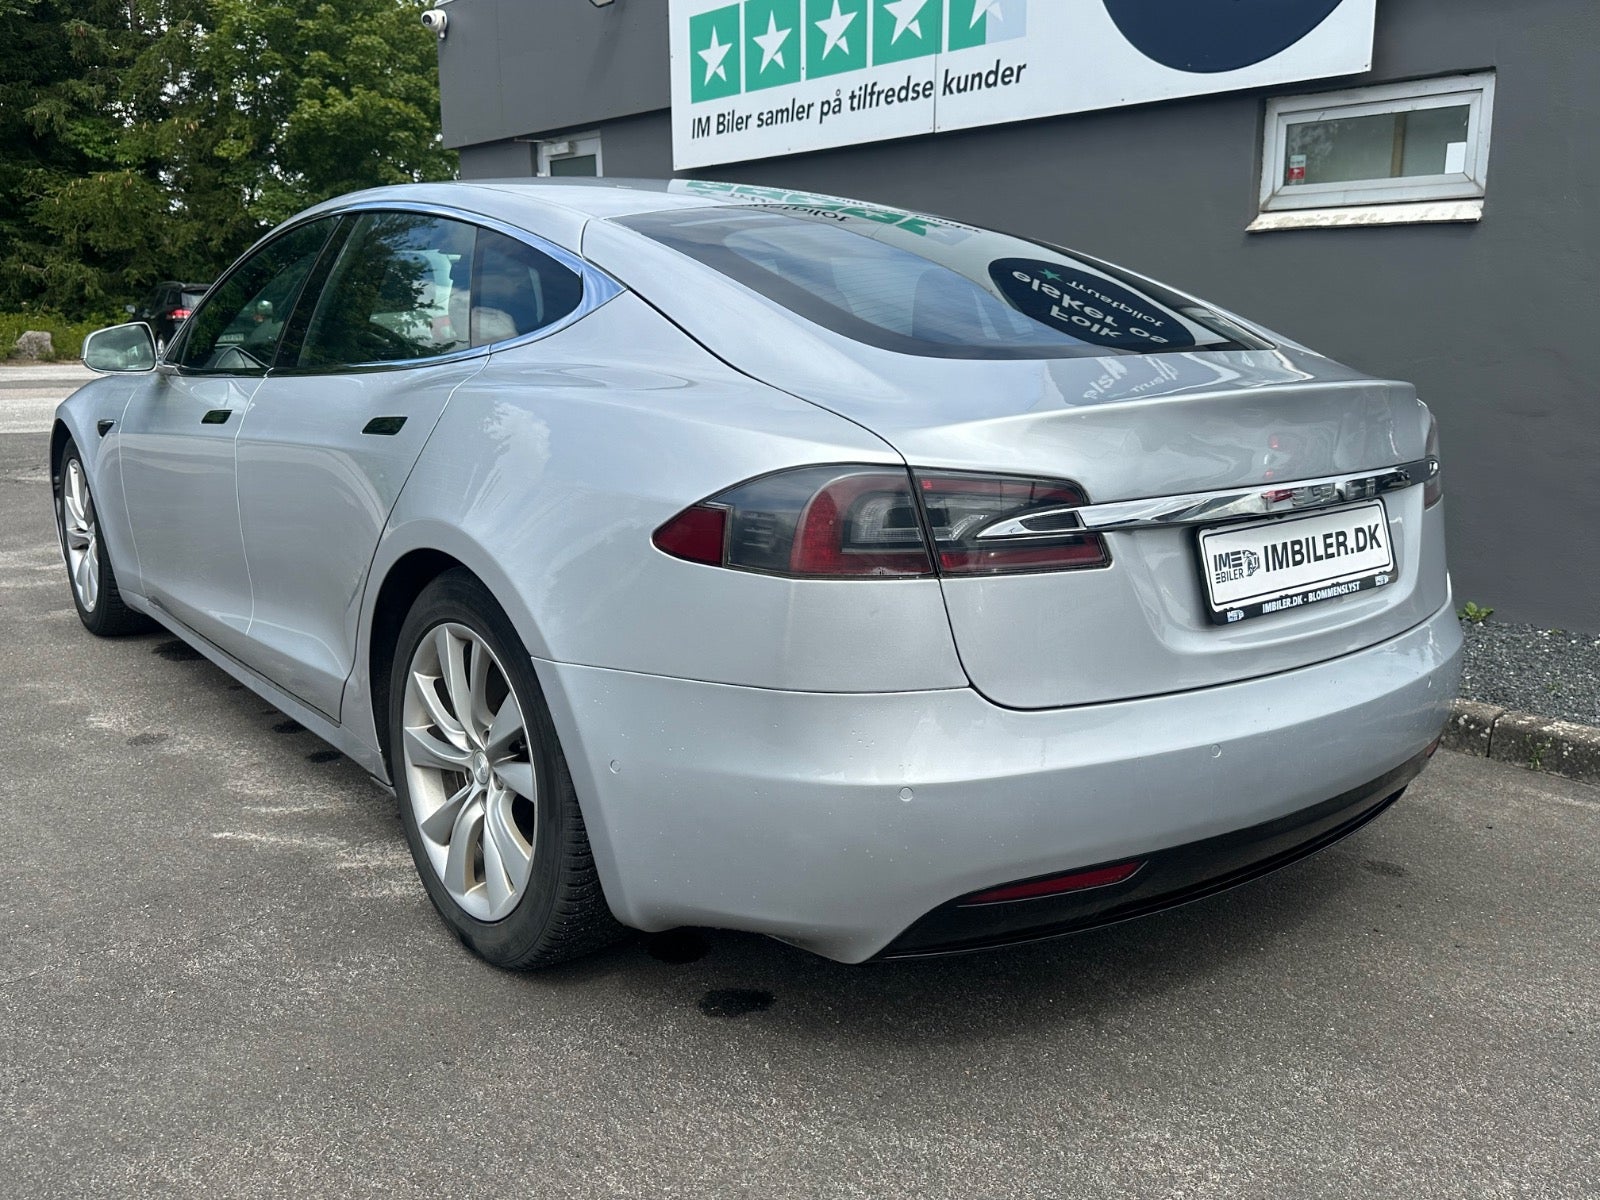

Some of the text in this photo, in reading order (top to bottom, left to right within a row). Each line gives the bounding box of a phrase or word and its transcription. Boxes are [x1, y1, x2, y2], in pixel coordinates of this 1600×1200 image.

[692, 59, 1027, 139] IM Biler samler på tilfredse kunder
[1263, 523, 1382, 573] IMBILER.DK
[1262, 595, 1303, 614] IMBILER.DK
[1308, 581, 1361, 602] BLOMMENSLYST
